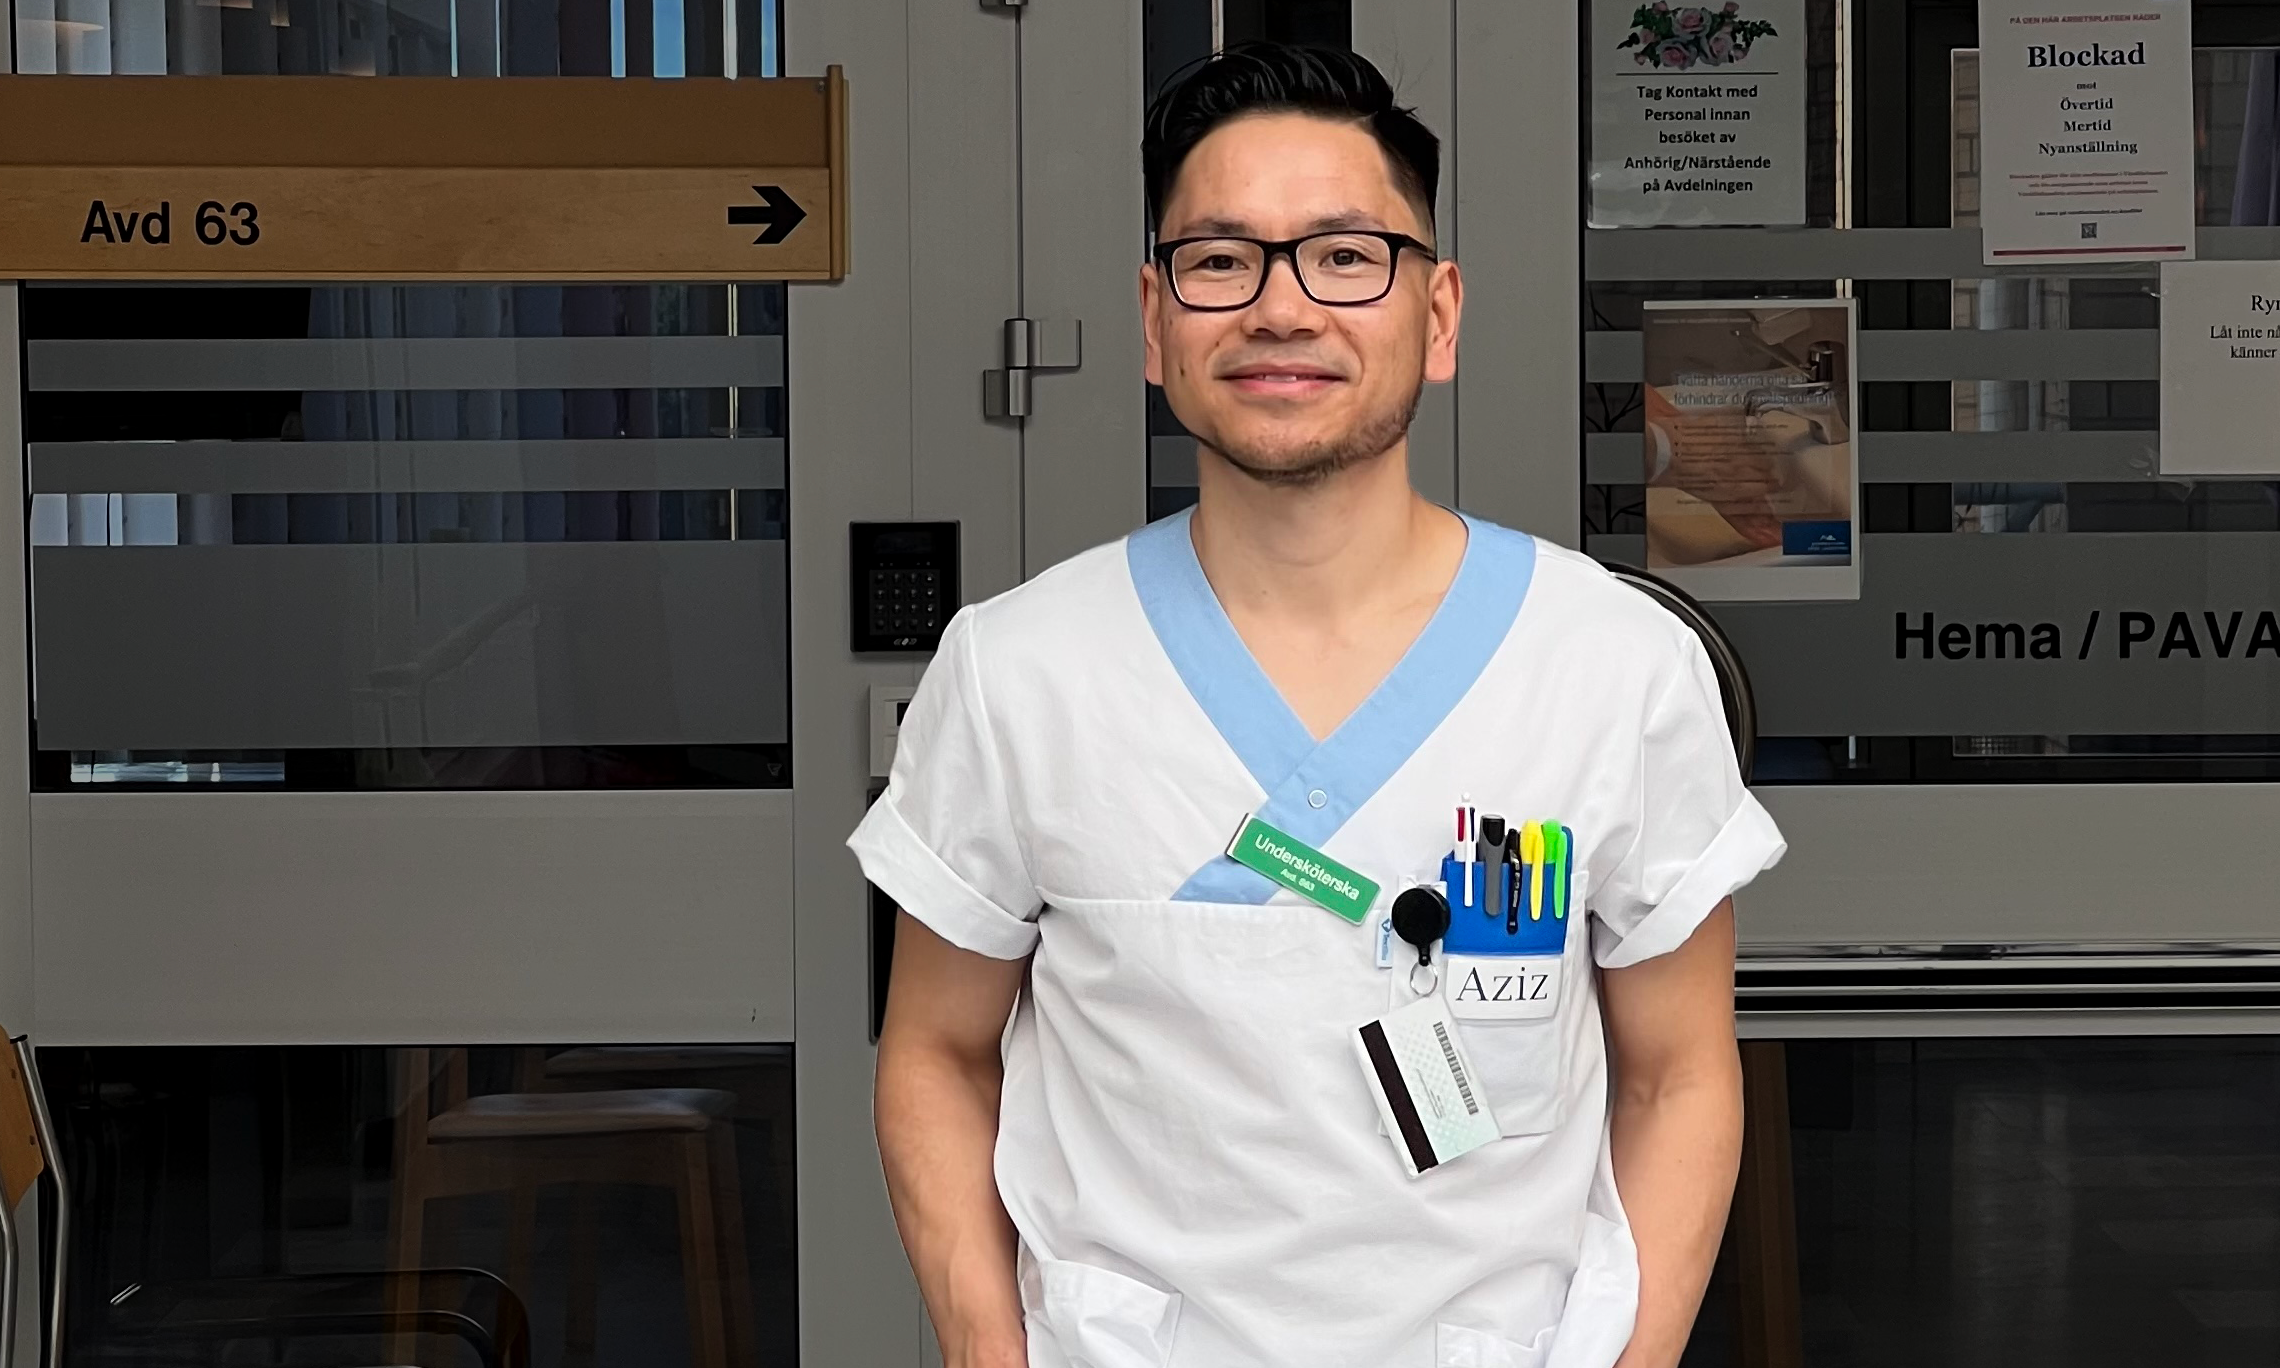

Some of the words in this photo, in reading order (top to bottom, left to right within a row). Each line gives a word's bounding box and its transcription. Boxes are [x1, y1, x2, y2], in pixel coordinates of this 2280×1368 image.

[2027, 42, 2146, 67] Blockad
[1637, 85, 1662, 101] Tag
[1666, 85, 1722, 98] Kontakt
[1727, 85, 1758, 98] med
[2077, 82, 2097, 90] mot
[2060, 96, 2113, 111] Övertid
[1645, 108, 1706, 121] Personal
[1710, 108, 1750, 121] innan
[2063, 119, 2111, 132] Mertid
[1659, 131, 1715, 144] besöket
[1720, 133, 1736, 143] av
[2038, 140, 2138, 157] Nyanställning
[1624, 155, 1771, 171] Anhörig/Närstående
[1643, 178, 1660, 194] på
[1664, 179, 1753, 194] Avdelningen
[80, 200, 170, 245] Avd
[195, 201, 260, 246] 63
[2210, 324, 2232, 339] Låt
[2237, 324, 2263, 339] inte
[2230, 345, 2278, 359] känner
[1674, 391, 1729, 406] förhindrar
[1895, 611, 2062, 660] Hema
[2078, 610, 2100, 660] /
[2119, 611, 2280, 659] PAVA
[1255, 834, 1359, 900] Undersköterska
[1455, 966, 1549, 1001] Aziz
